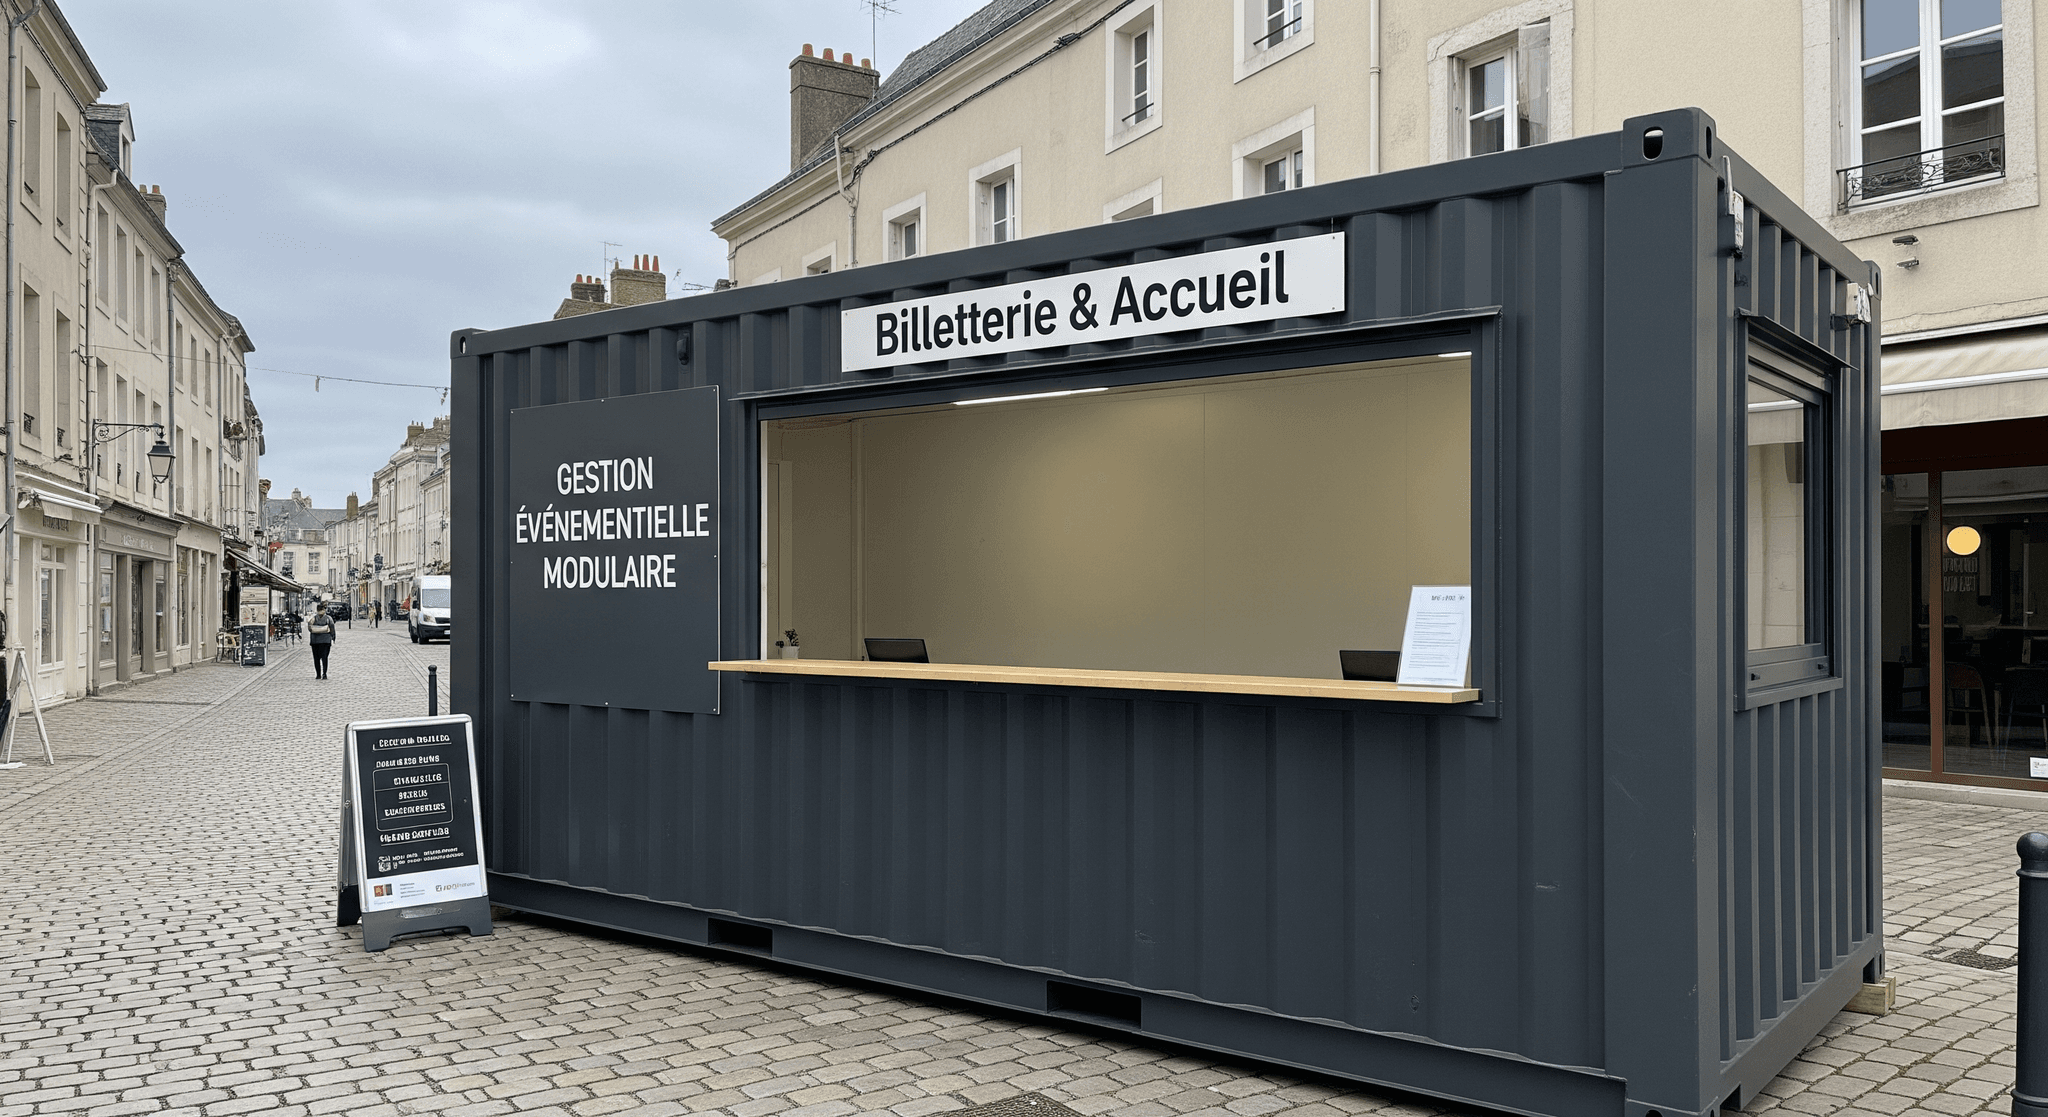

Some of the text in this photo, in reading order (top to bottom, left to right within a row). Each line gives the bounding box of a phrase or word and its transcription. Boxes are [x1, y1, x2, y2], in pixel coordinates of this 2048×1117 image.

[876, 249, 1289, 357] Billetterie & Accueil
[557, 456, 653, 495] GESTION
[516, 503, 710, 544] ÉVÉNEMENTIELLE
[543, 554, 677, 589] MODULAIRE
